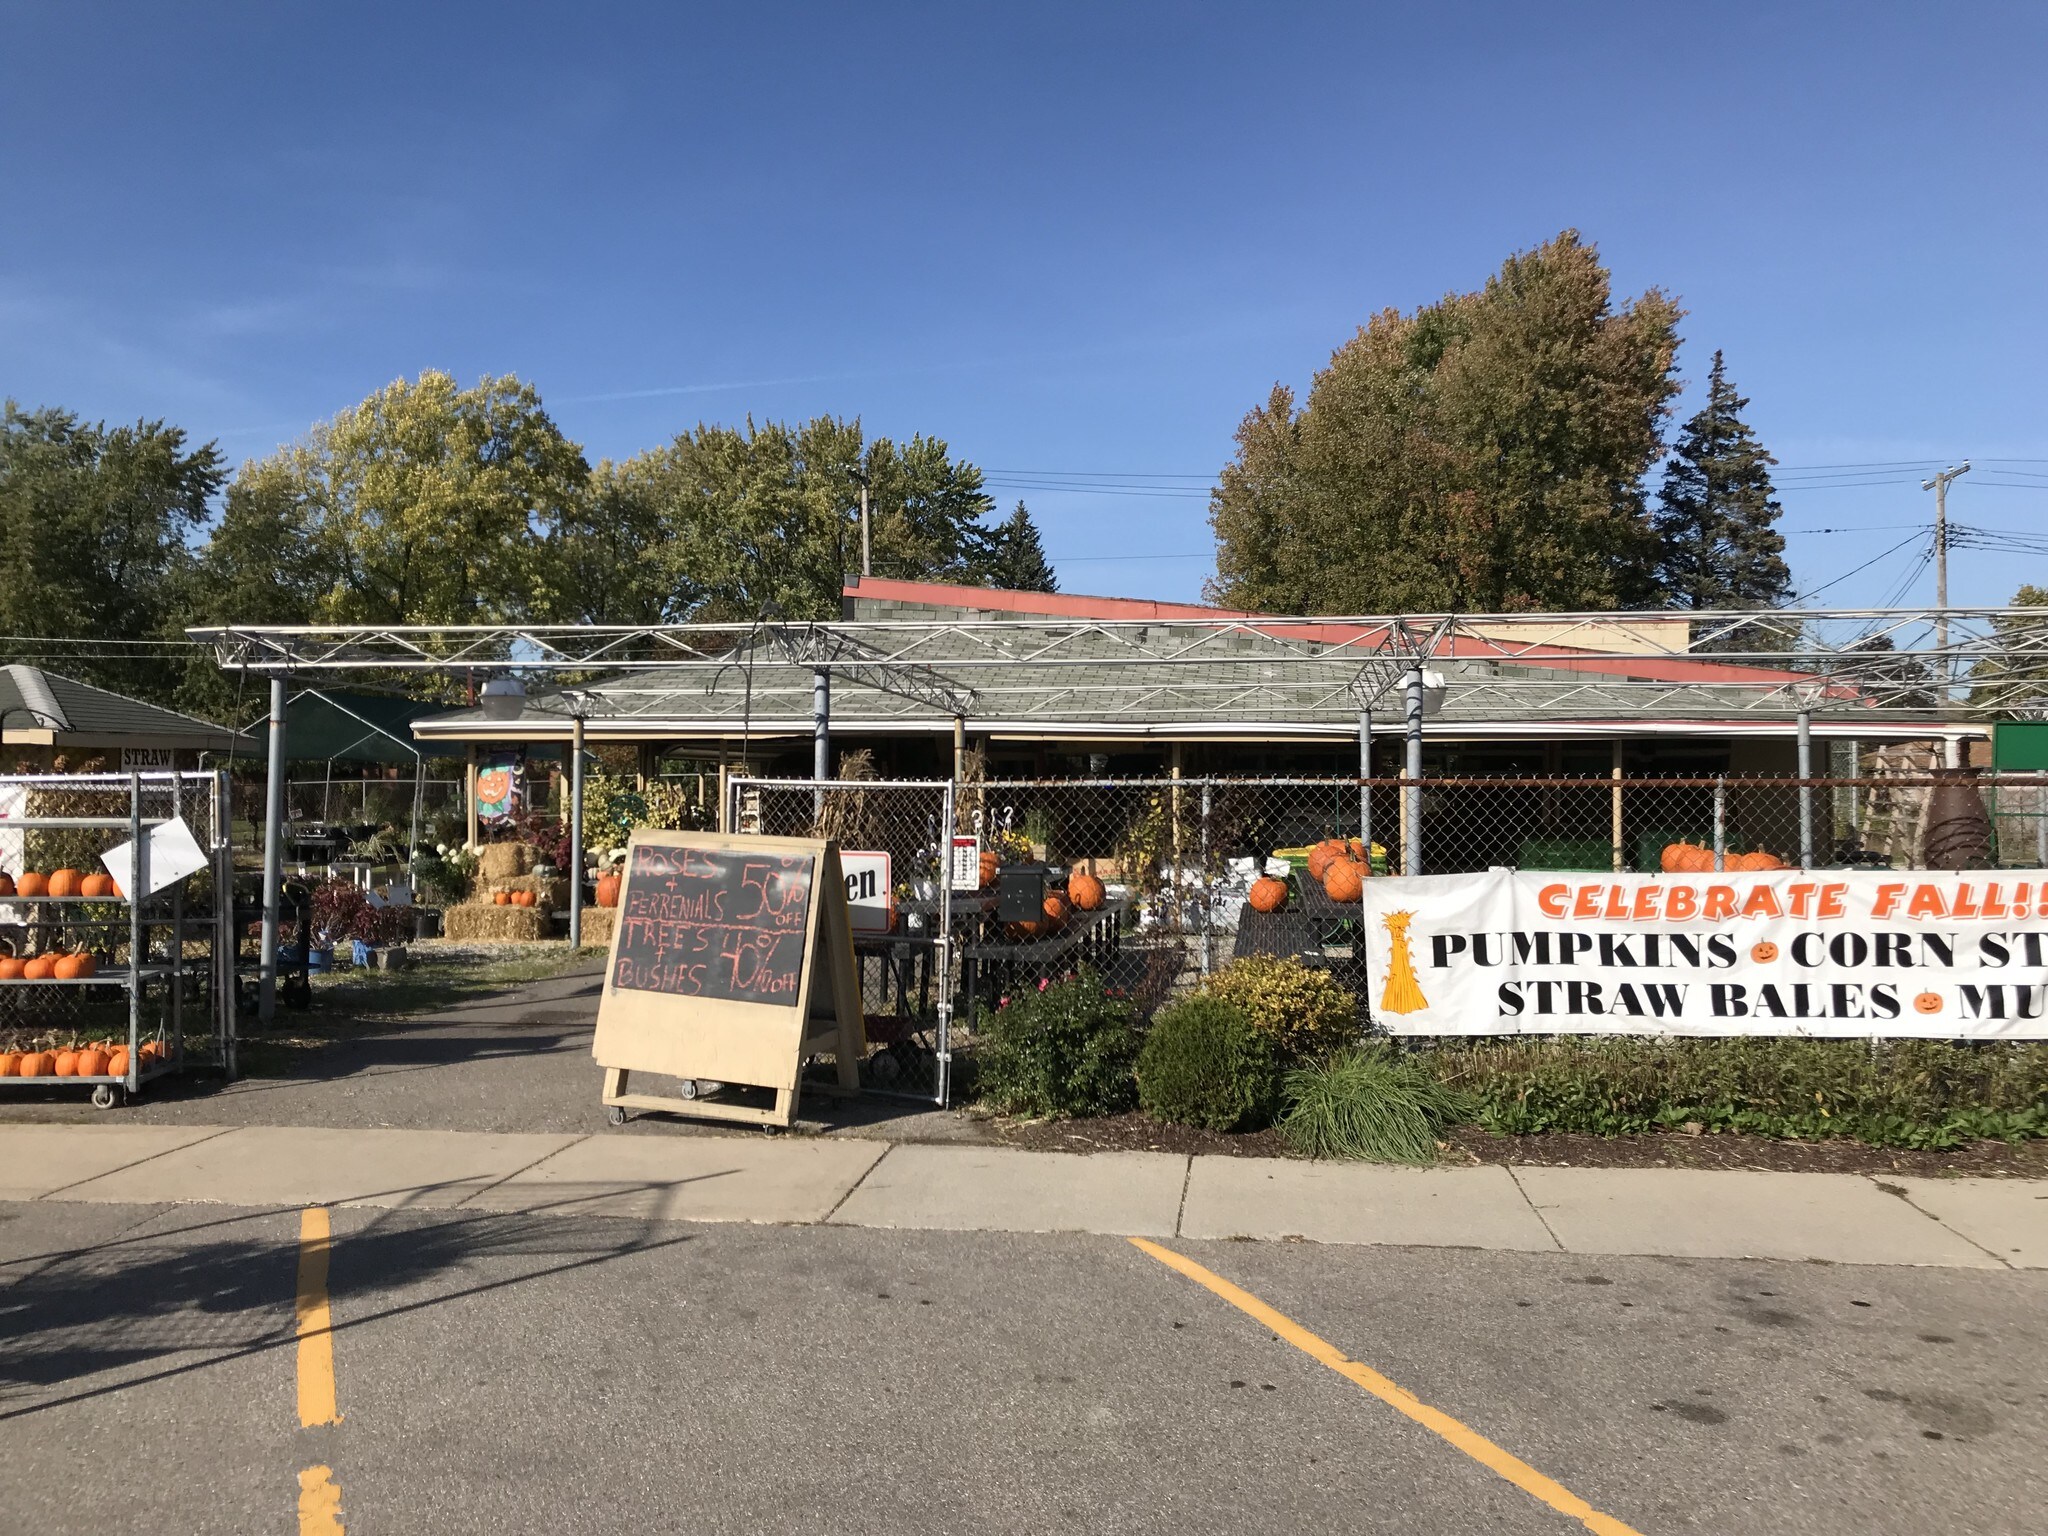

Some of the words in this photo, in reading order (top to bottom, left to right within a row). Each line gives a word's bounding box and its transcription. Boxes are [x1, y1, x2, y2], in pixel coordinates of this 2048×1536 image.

[124, 748, 171, 766] STRAW
[636, 846, 718, 879] ROSES
[628, 890, 728, 921] PERRENIALS
[1537, 882, 1850, 922] CELEBRATE
[1870, 882, 2048, 921] FALL!!
[775, 911, 802, 926] OFF
[623, 919, 712, 951] TREES
[1428, 931, 1738, 969] PUMPKINS
[1790, 931, 1960, 968] CORN
[617, 957, 707, 996] BUSHES
[770, 972, 797, 992] OFF
[1498, 980, 1690, 1018] STRAW
[1706, 983, 1901, 1019] BALES
